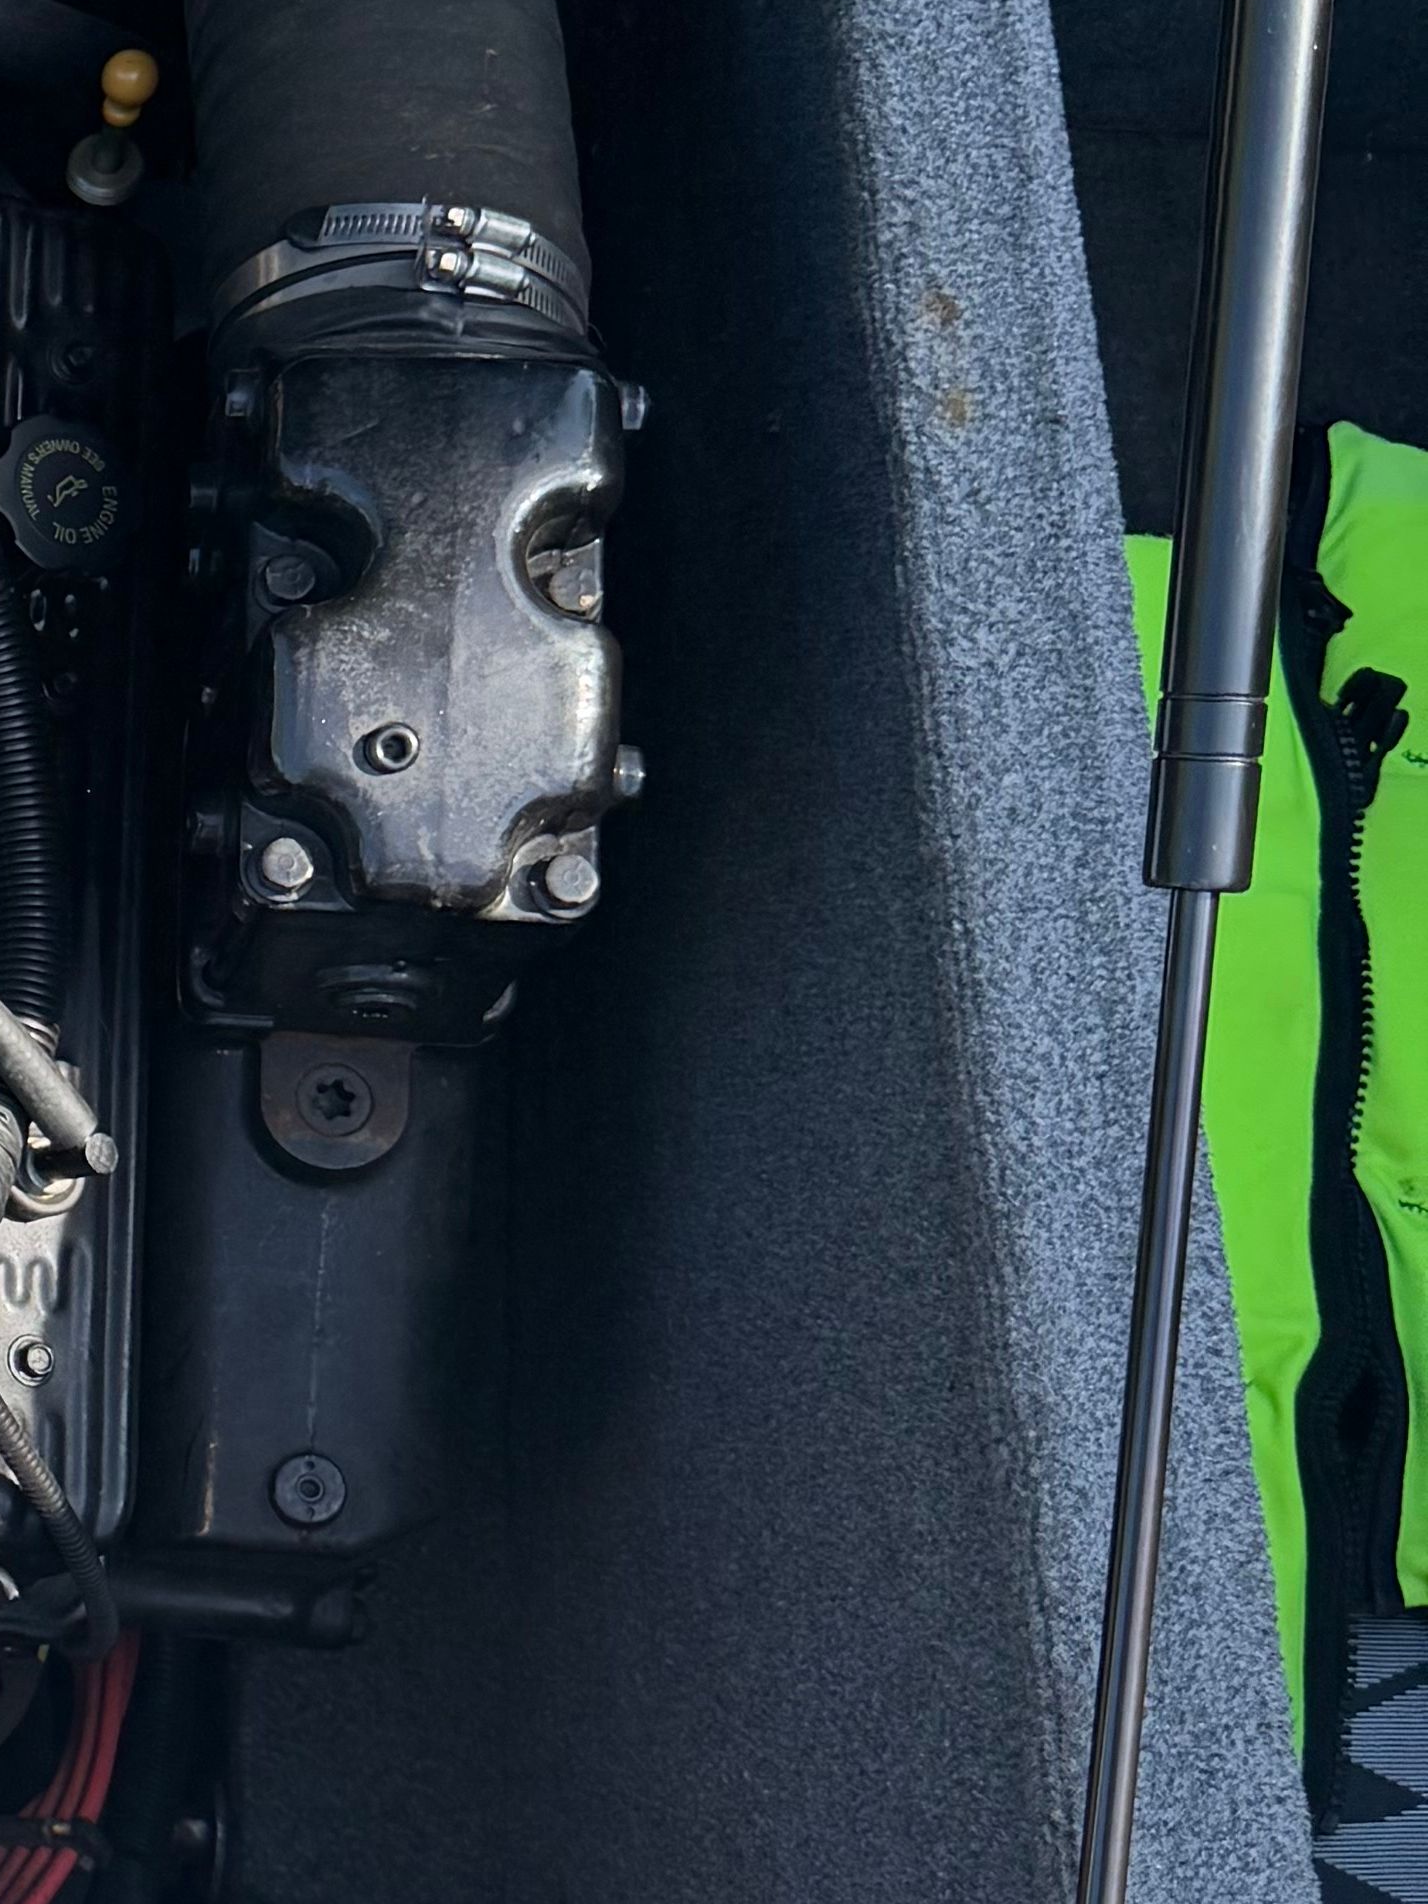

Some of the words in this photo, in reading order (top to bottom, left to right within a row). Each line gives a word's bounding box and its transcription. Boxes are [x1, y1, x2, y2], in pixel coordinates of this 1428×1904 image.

[19, 462, 41, 521] MANUAL
[80, 486, 119, 544] ENGINE
[52, 521, 77, 545] OIL
